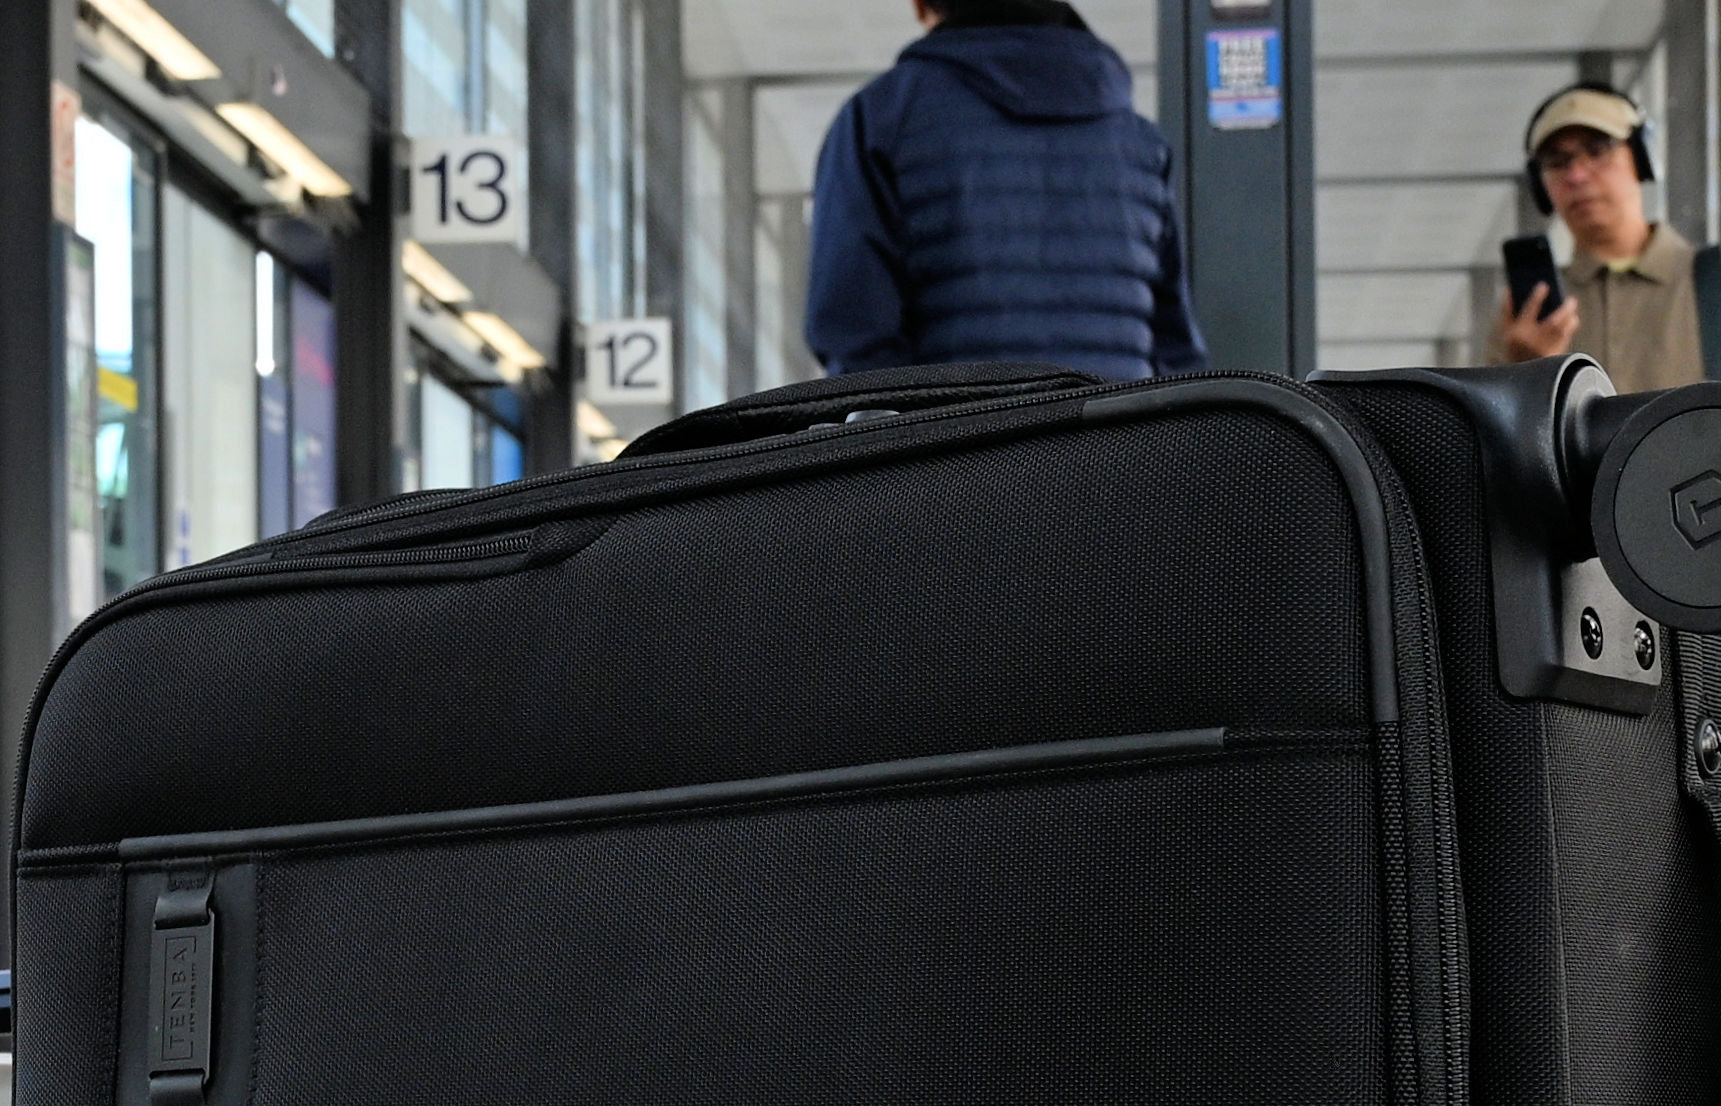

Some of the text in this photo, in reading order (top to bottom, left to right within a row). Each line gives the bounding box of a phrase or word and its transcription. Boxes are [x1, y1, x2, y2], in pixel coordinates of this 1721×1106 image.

[421, 150, 509, 225] 13
[596, 331, 659, 388] 12
[169, 947, 186, 1049] TENBA
